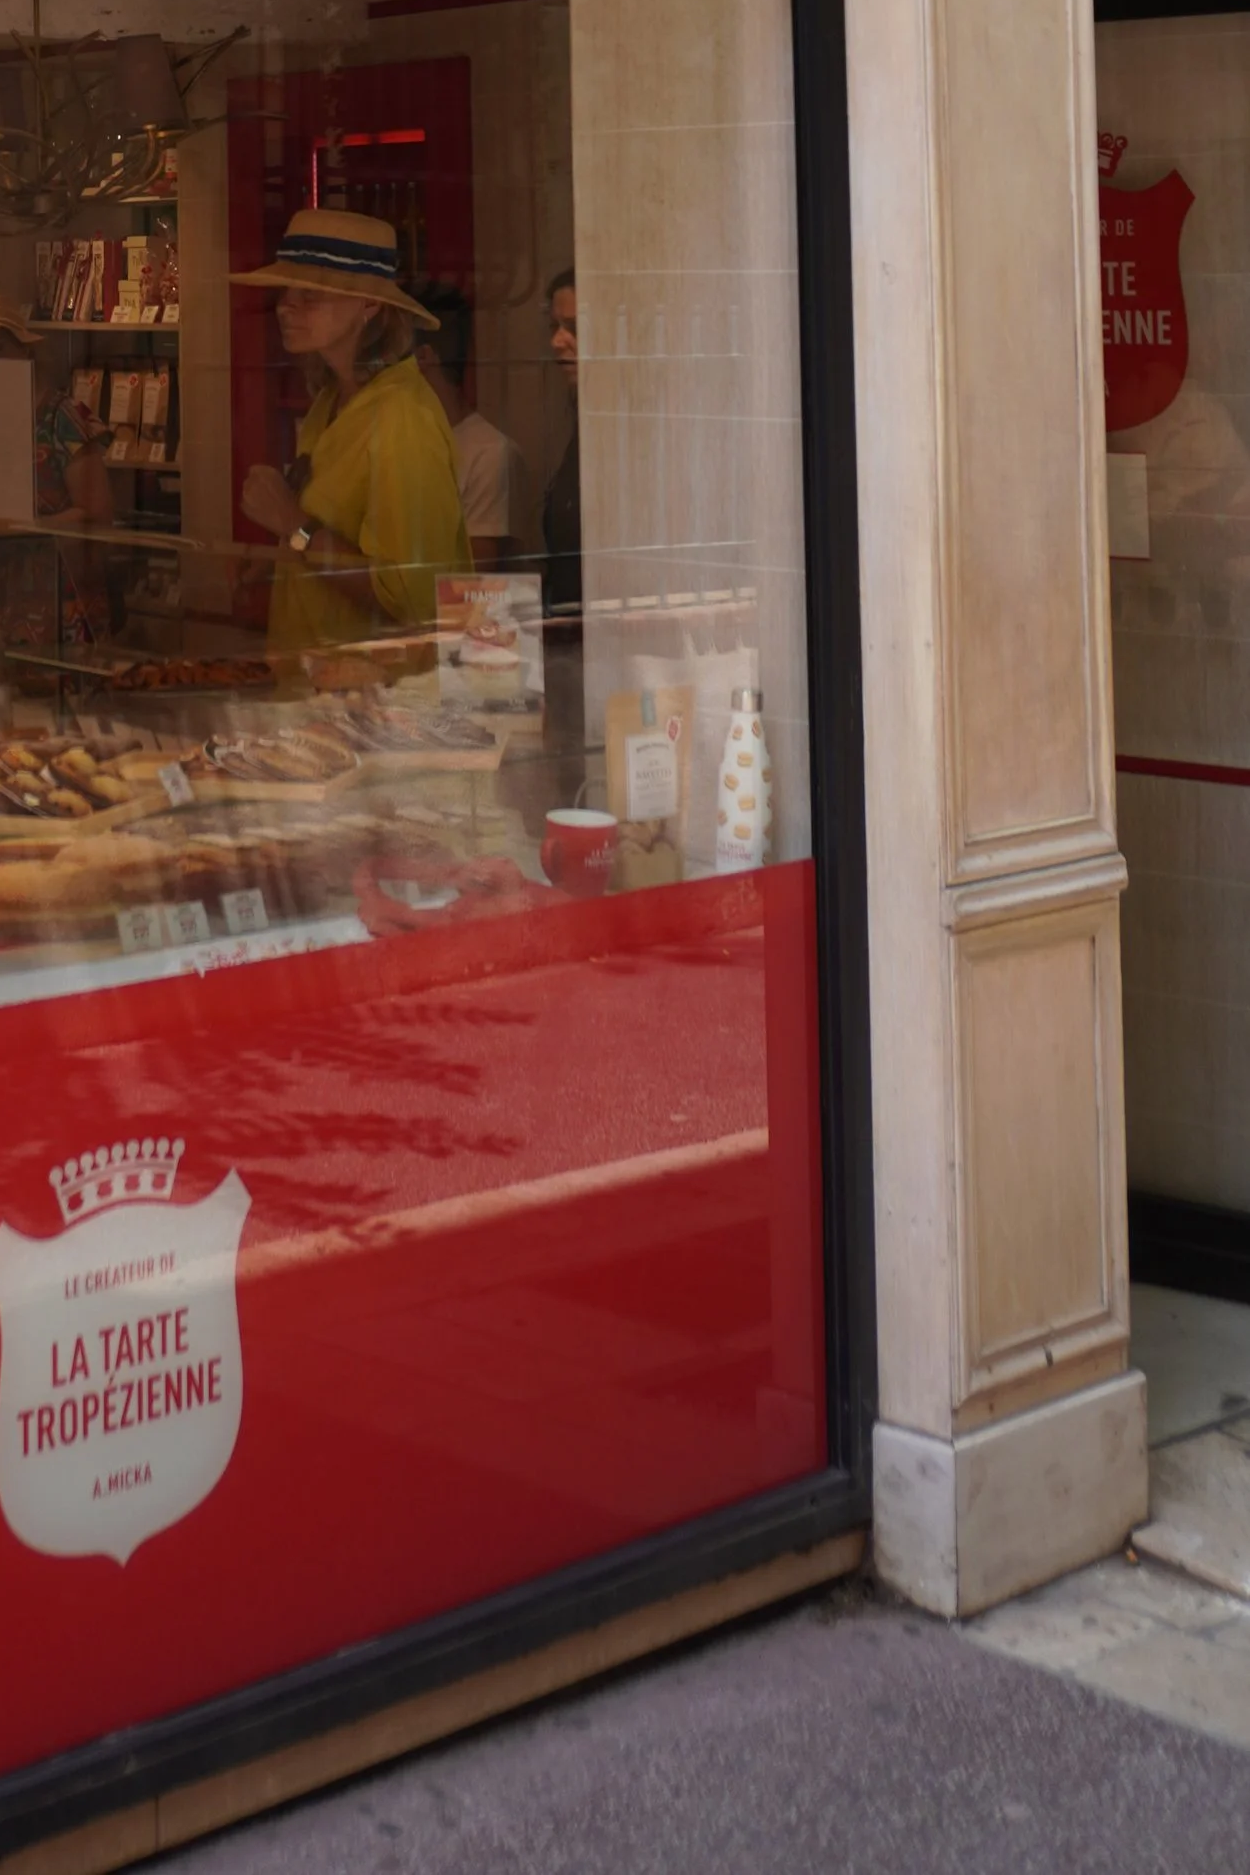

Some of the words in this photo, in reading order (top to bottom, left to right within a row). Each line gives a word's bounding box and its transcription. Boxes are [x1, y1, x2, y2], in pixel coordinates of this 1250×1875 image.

[1115, 219, 1135, 236] DE
[64, 1273, 80, 1300] LE
[160, 1250, 177, 1275] DE
[52, 1333, 90, 1389] LA
[99, 1307, 189, 1373] TARTE
[17, 1357, 222, 1458] TROPÉZIENNE
